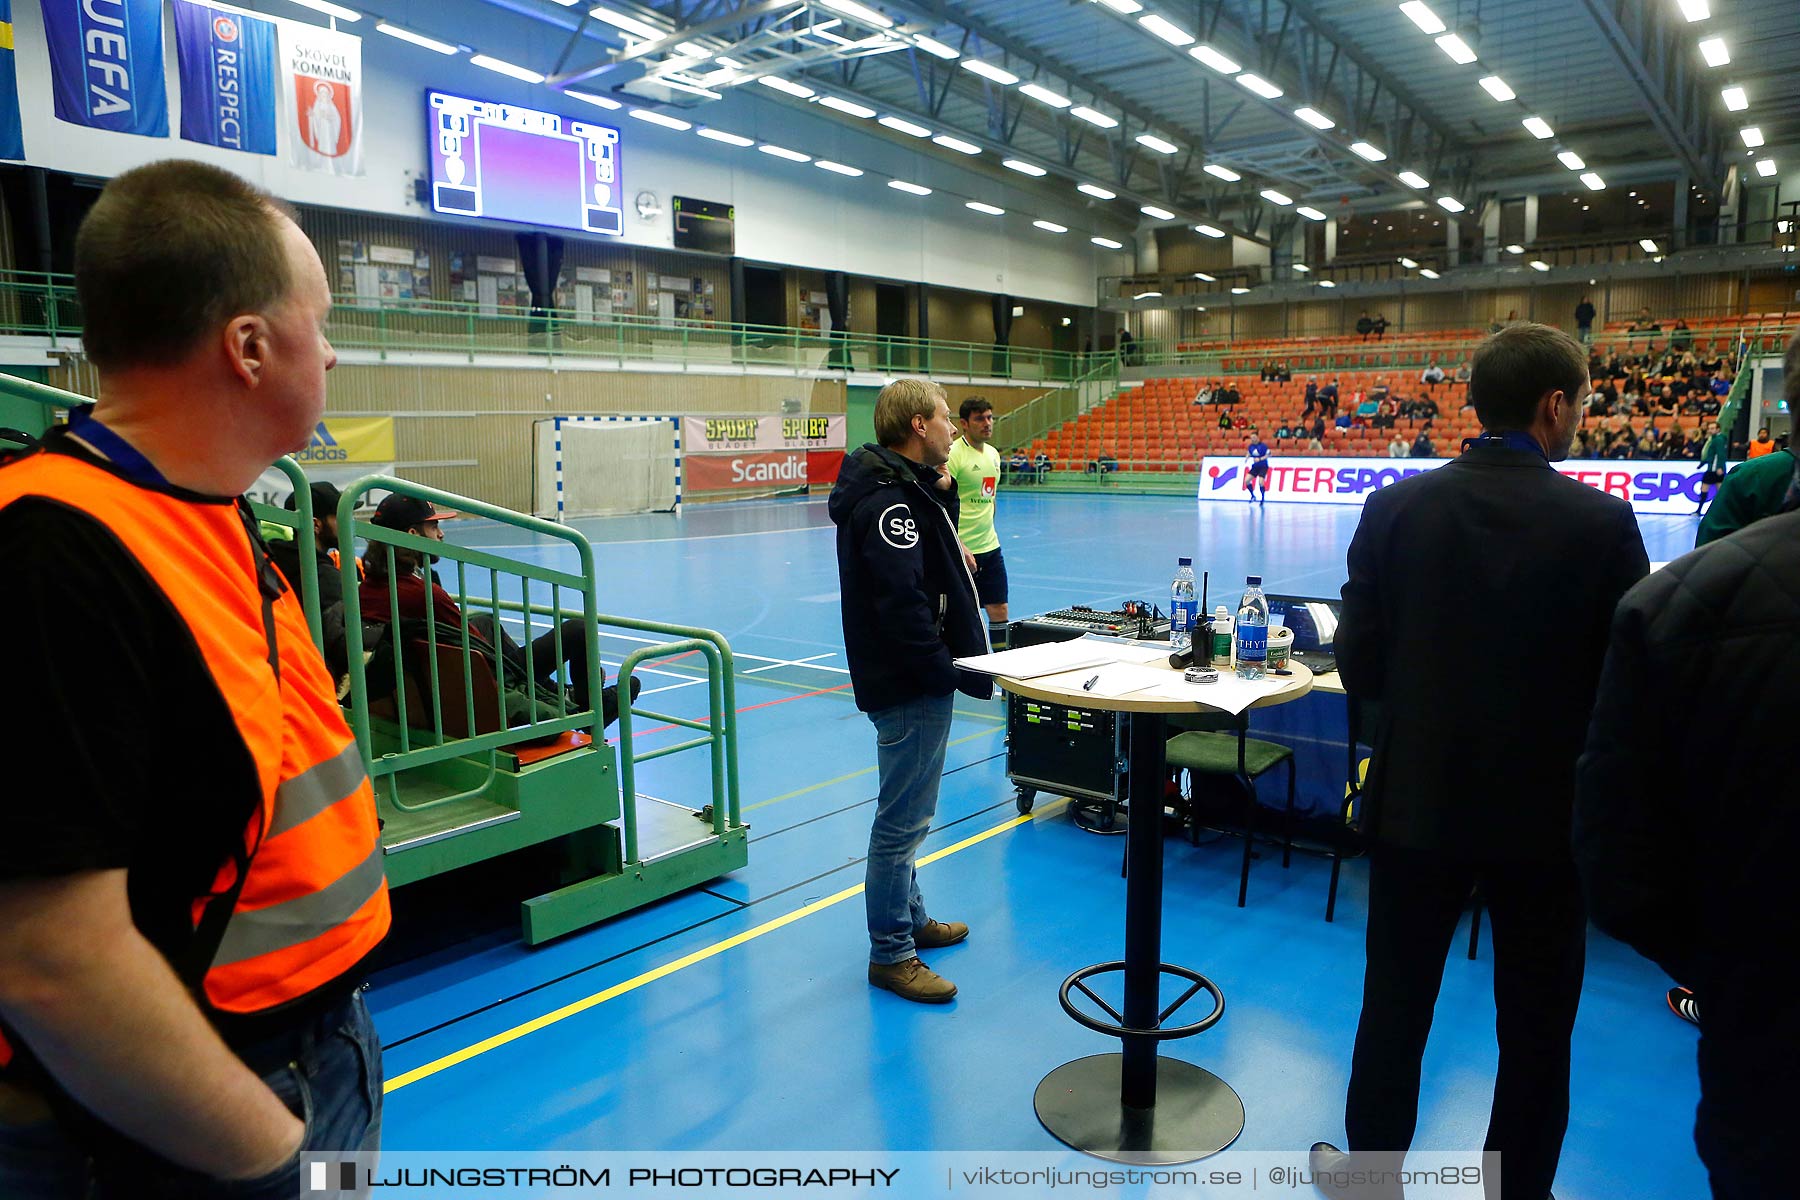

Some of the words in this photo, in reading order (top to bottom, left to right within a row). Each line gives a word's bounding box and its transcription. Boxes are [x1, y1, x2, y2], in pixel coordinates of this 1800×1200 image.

[82, 0, 131, 116] UEFA
[292, 58, 352, 82] KOMMUN
[217, 48, 241, 149] RESPECT
[705, 418, 758, 441] SPORT
[782, 417, 828, 440] SPORT
[708, 441, 757, 450] BLADET
[784, 439, 828, 448] BLADET
[731, 455, 808, 483] Scandic
